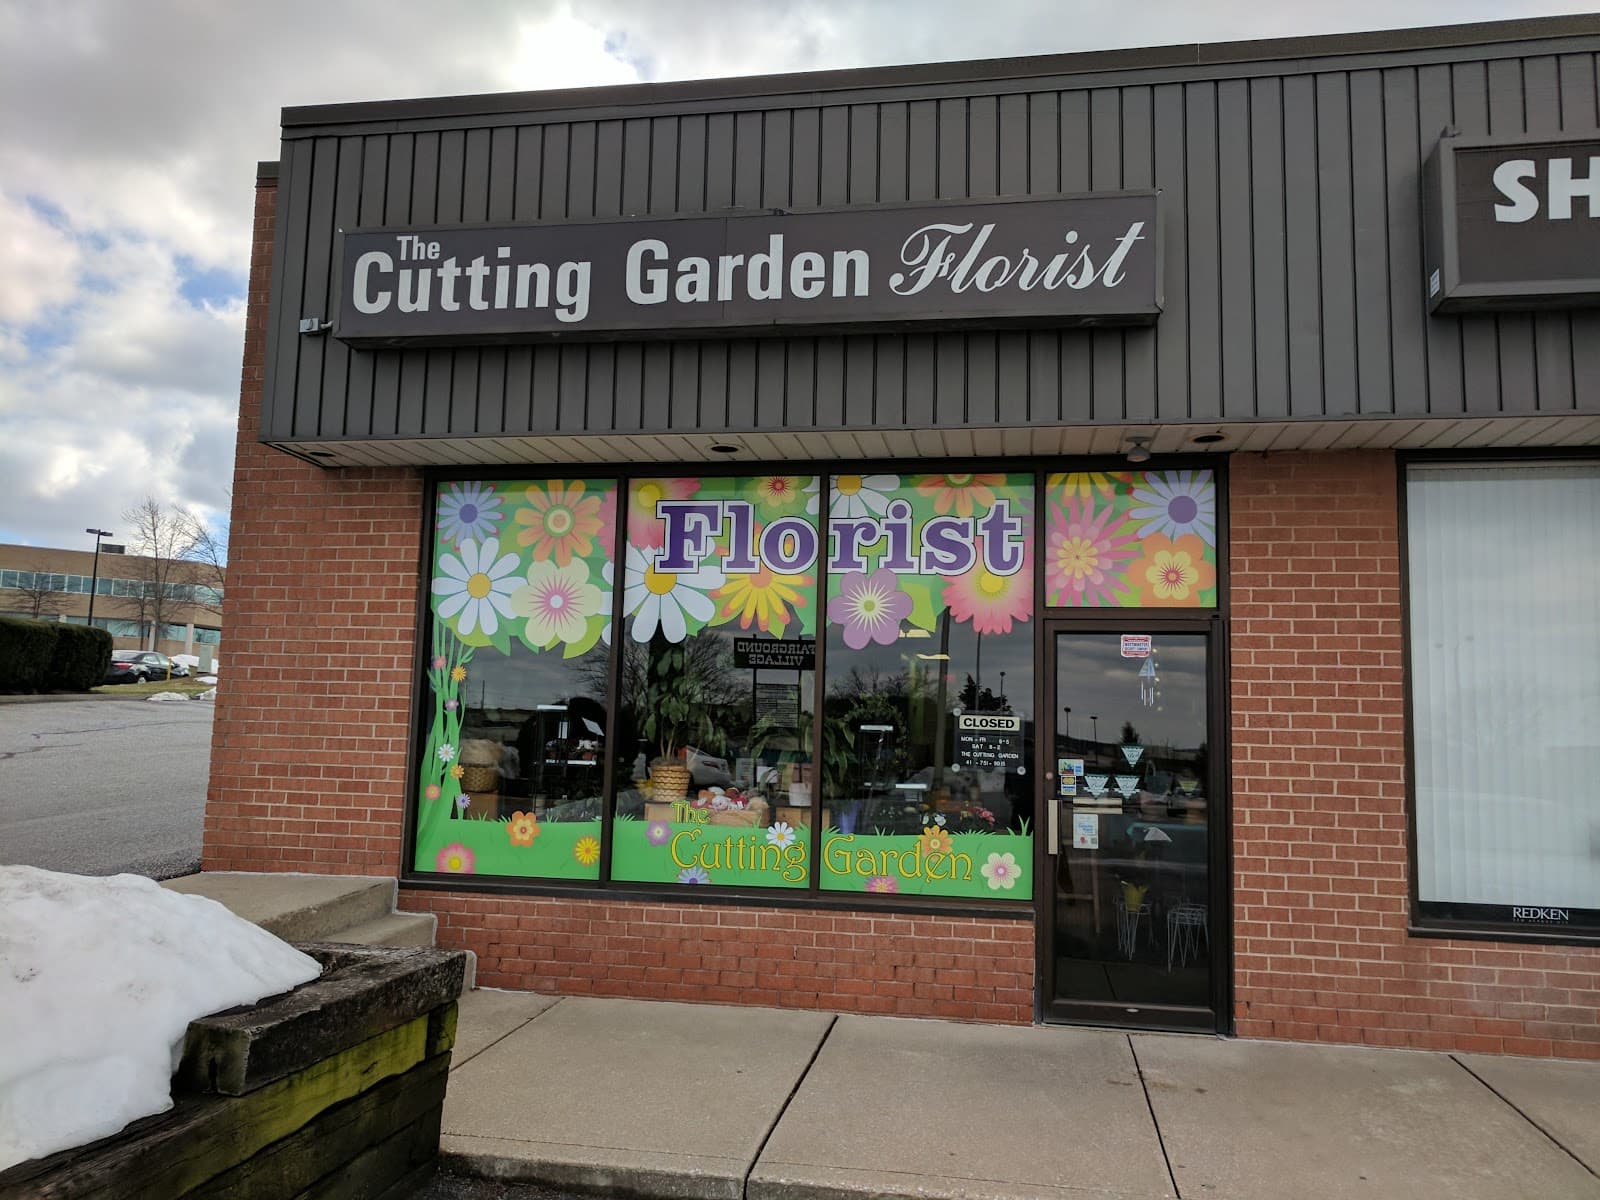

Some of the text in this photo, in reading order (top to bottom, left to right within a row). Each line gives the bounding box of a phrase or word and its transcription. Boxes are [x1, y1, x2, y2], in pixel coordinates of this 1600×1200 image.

[1492, 156, 1600, 223] SH
[396, 235, 441, 262] The
[352, 221, 1145, 323] Cutting Garden Florist
[654, 499, 1024, 576] Florist
[963, 717, 1015, 729] CLOSED
[671, 799, 710, 825] The
[671, 828, 973, 883] Cutting Garden
[1512, 907, 1569, 920] REDKEN
